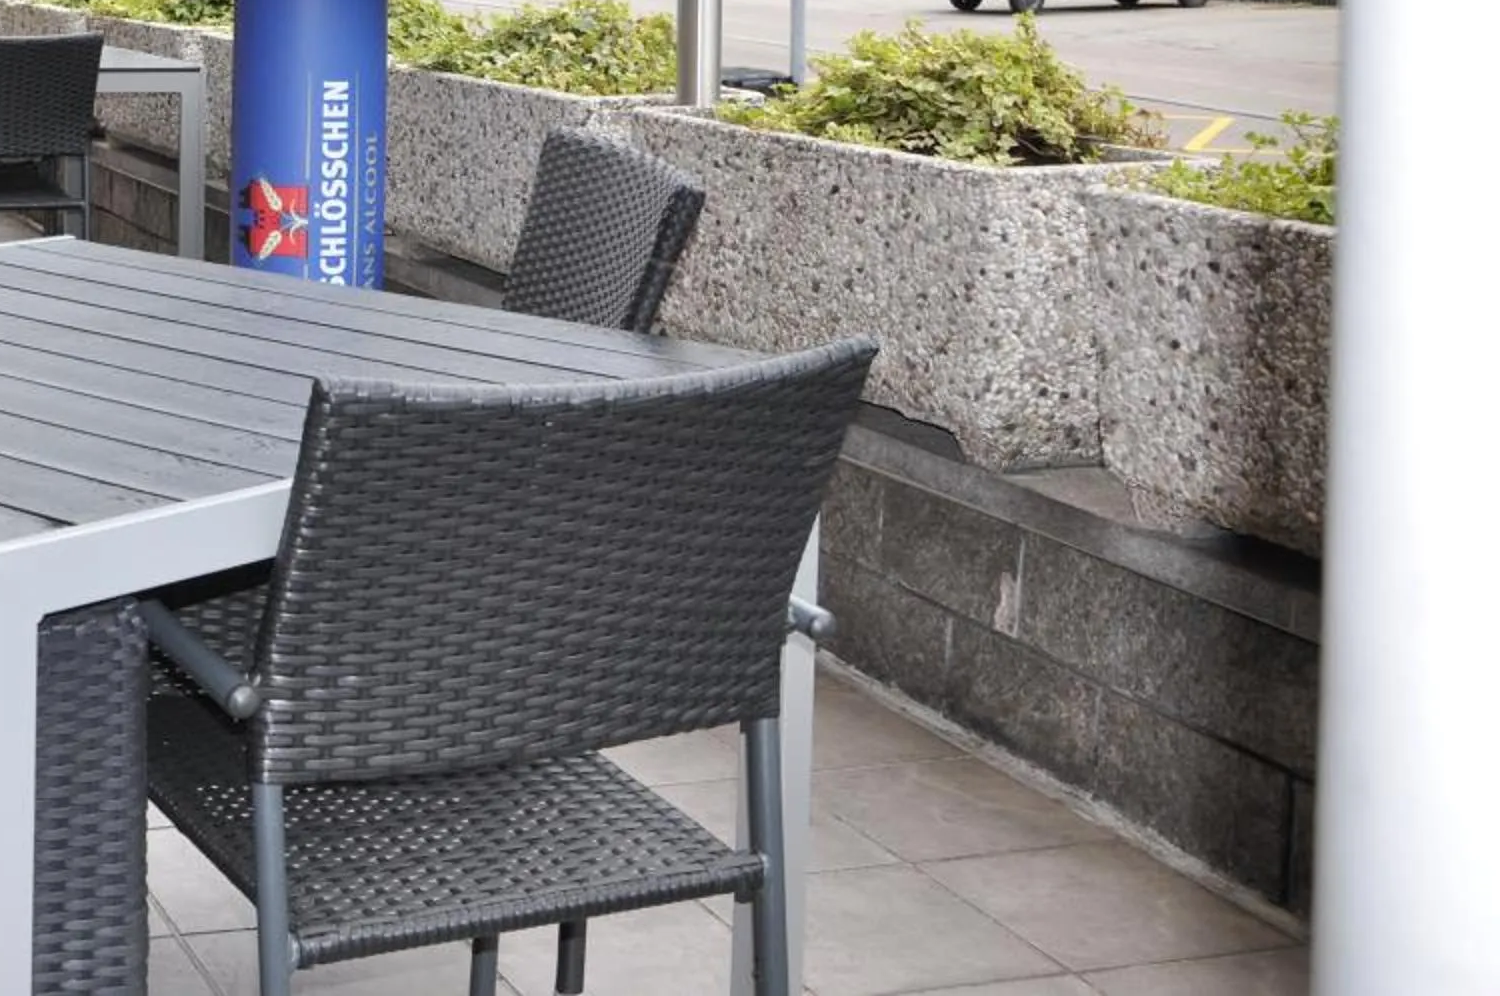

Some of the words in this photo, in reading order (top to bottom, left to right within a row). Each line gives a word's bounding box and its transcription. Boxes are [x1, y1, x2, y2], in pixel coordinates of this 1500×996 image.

[314, 80, 349, 286] SCHLÖSSCHEN
[364, 131, 378, 234] ALCOOL
[363, 242, 376, 289] ANS
